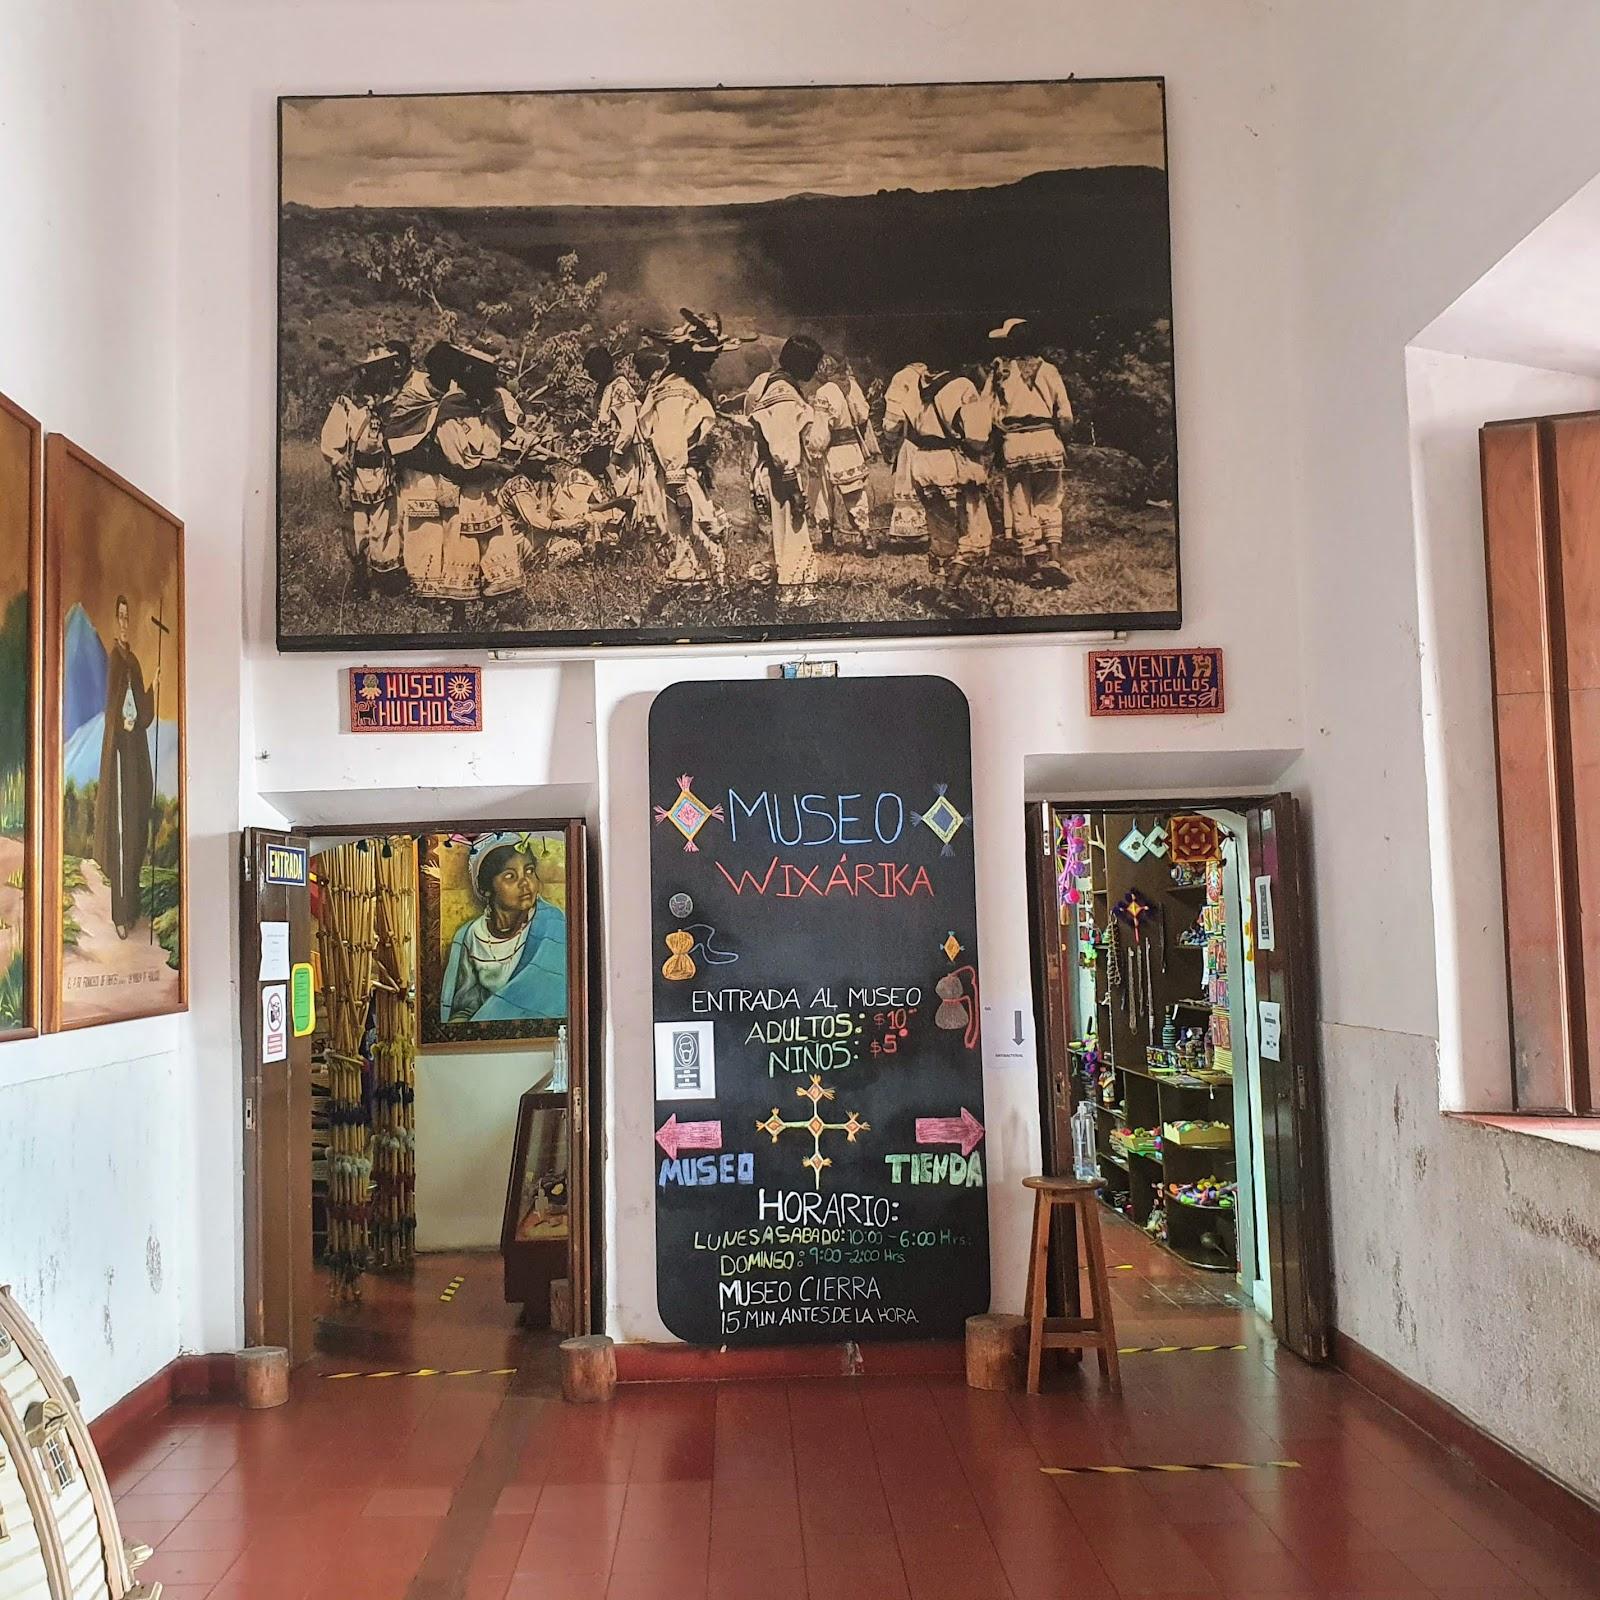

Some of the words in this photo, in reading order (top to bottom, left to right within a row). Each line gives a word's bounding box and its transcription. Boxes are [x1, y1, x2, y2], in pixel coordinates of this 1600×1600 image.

[1127, 656, 1187, 678] VENTA
[1105, 681, 1123, 693] DE
[1131, 679, 1210, 693] ARTICULOS
[1119, 694, 1198, 709] HUICHOLES
[379, 700, 454, 726] HUICHOL
[728, 788, 904, 845] MUSEO
[269, 849, 303, 880] ENTRADA
[715, 853, 934, 897] WIXÁRIKA
[692, 988, 800, 1013] ENTRADA
[810, 987, 838, 1010] AL
[848, 986, 921, 1007] MUSEO
[745, 1012, 867, 1045] ADULTOS:
[768, 1039, 860, 1078] NIÑOS:
[659, 1152, 755, 1188] MUSEO
[885, 1150, 984, 1188] TIENDA
[758, 1188, 900, 1228] HORARIO:
[694, 1229, 759, 1251] LUNES
[900, 1230, 936, 1248] 6:00
[809, 1247, 842, 1264] 9:00
[719, 1279, 792, 1310] MUSEO
[800, 1276, 881, 1302] CIERRA
[721, 1311, 740, 1335] 15
[779, 1307, 830, 1326] ANTES
[831, 1307, 851, 1324] DE
[855, 1308, 874, 1324] LA
